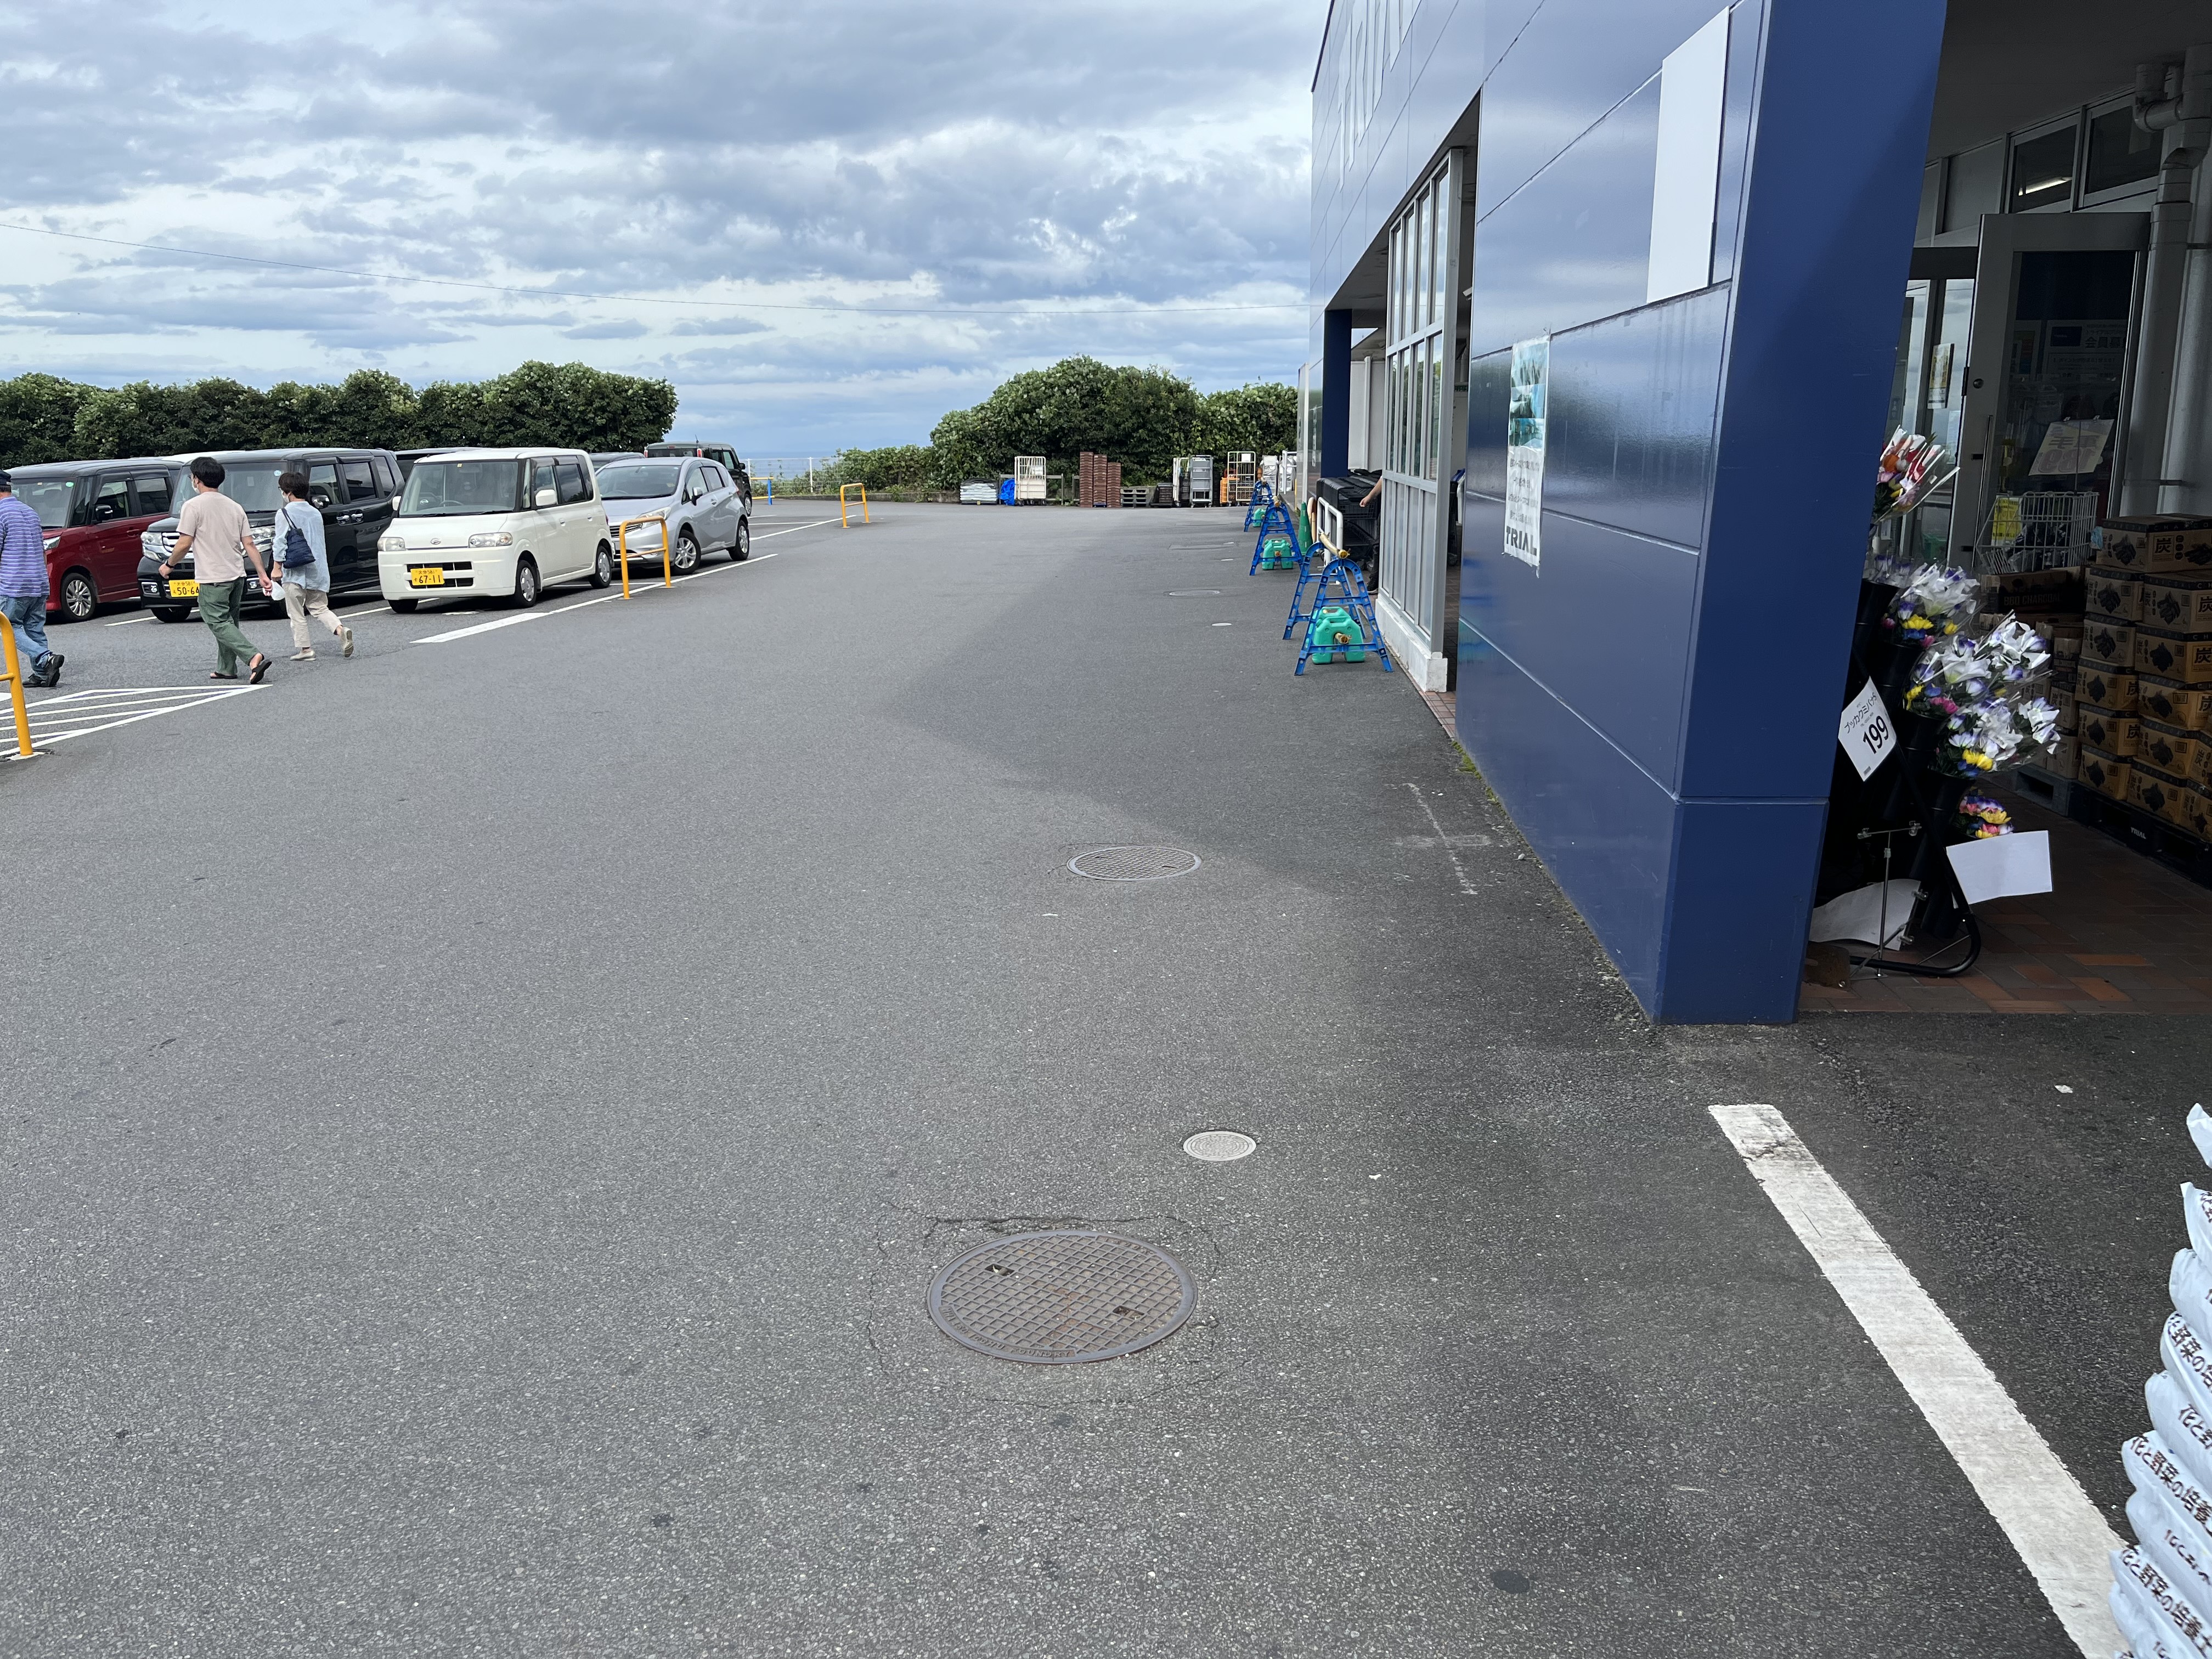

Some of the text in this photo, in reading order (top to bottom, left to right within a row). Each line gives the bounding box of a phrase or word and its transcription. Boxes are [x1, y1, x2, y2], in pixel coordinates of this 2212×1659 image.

[2085, 336, 2126, 348] 会員募
[1506, 526, 1537, 556] TRIAL
[2155, 538, 2171, 553] 炭
[419, 575, 441, 583] 67-11
[2194, 647, 2211, 663] 炭
[1863, 715, 1889, 754] 199
[1011, 1348, 1070, 1357] FOUNDRY
